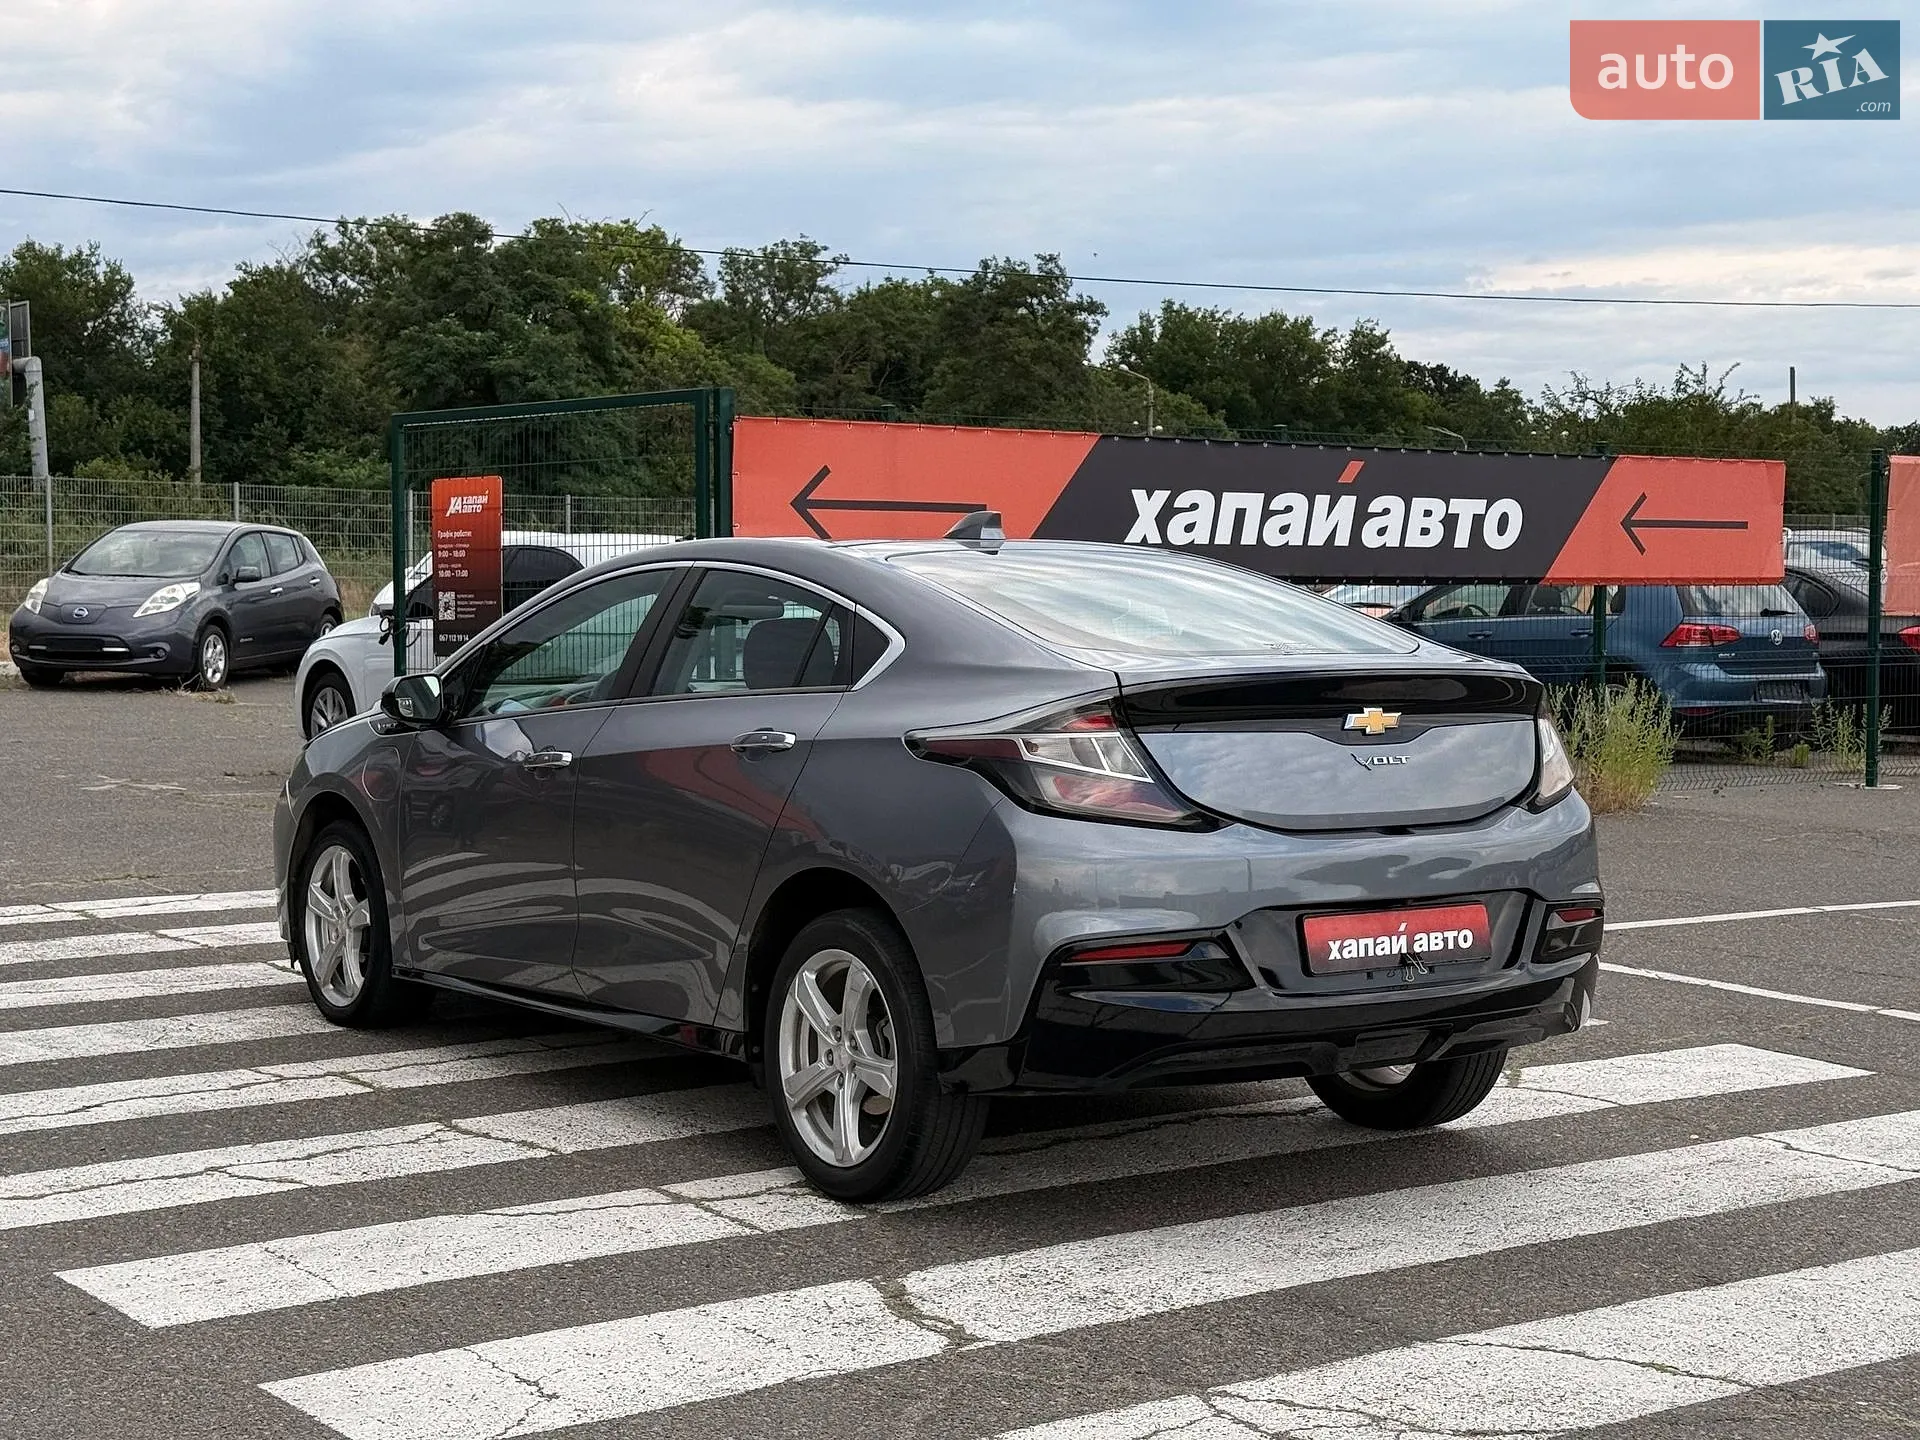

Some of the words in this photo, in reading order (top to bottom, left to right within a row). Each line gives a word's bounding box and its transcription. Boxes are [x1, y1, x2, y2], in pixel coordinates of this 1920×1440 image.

[1124, 460, 1364, 547] хапай
[1361, 495, 1523, 550] авто
[1350, 752, 1410, 771] VOLT
[1328, 922, 1408, 961] хапай
[1413, 928, 1474, 953] авто
